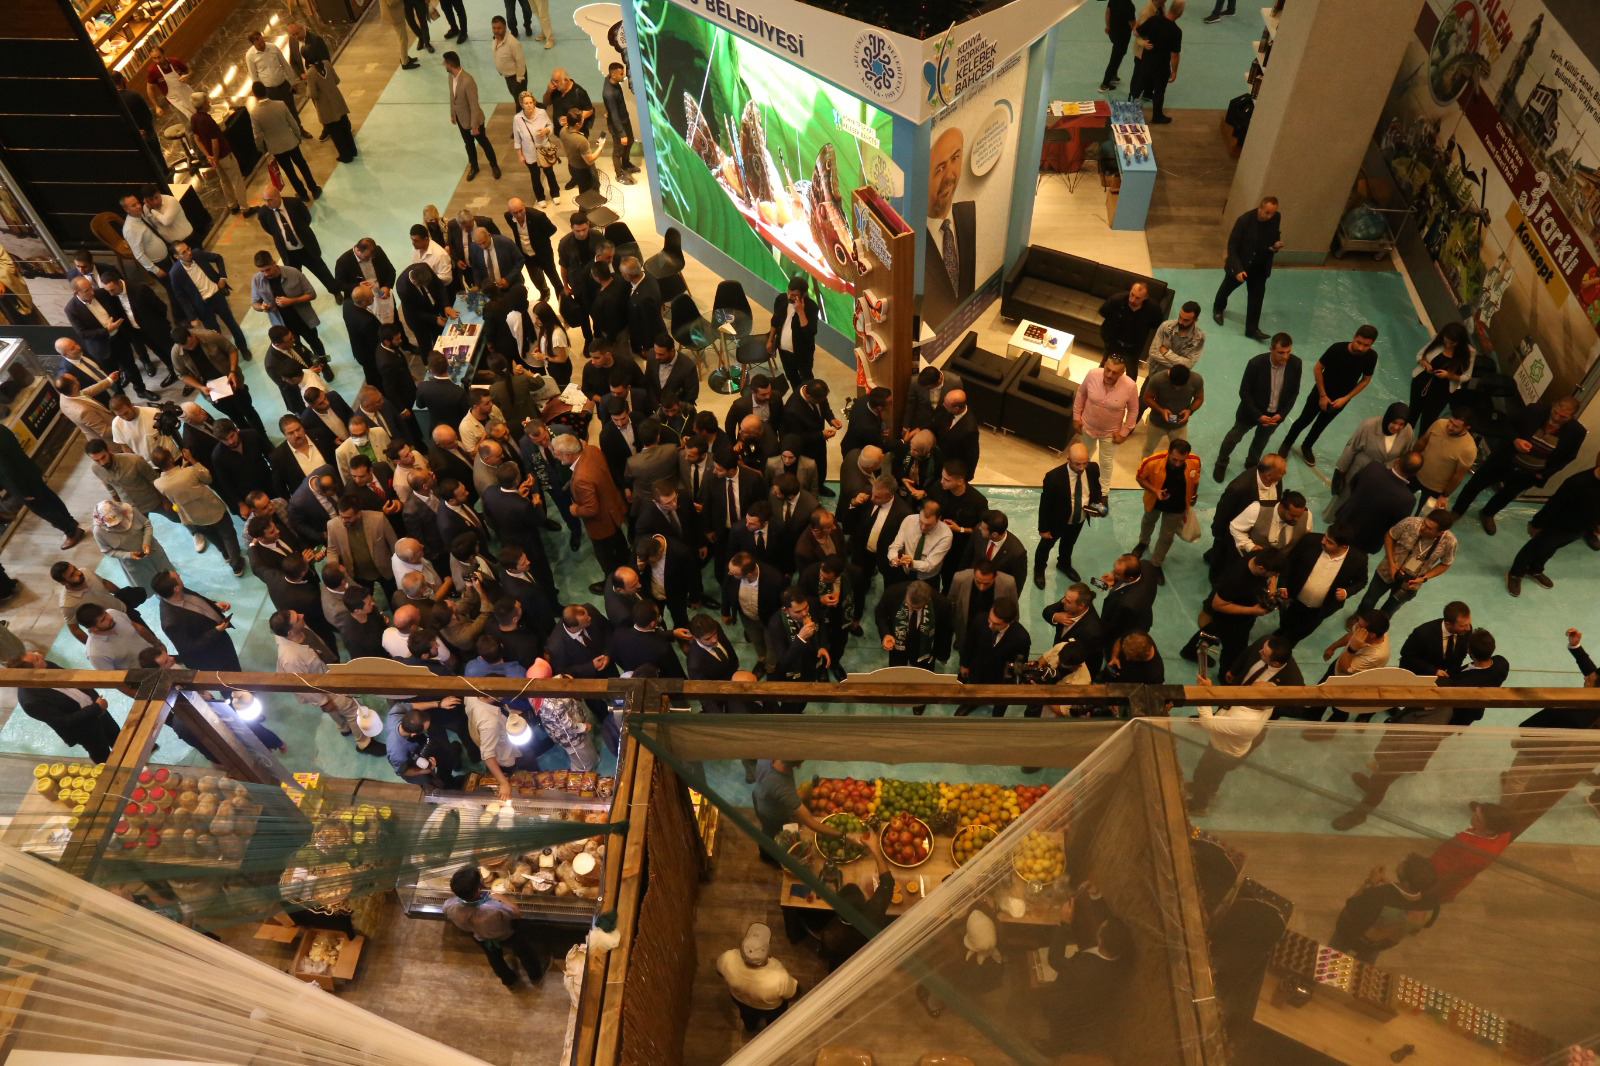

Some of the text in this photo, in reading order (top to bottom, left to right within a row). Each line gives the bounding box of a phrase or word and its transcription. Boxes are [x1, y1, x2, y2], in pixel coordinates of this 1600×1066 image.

[705, 0, 804, 58] BELEDİYESİ
[957, 32, 982, 56] KONYA
[956, 41, 998, 82] KELEBEK
[1515, 220, 1555, 285] Konsept
